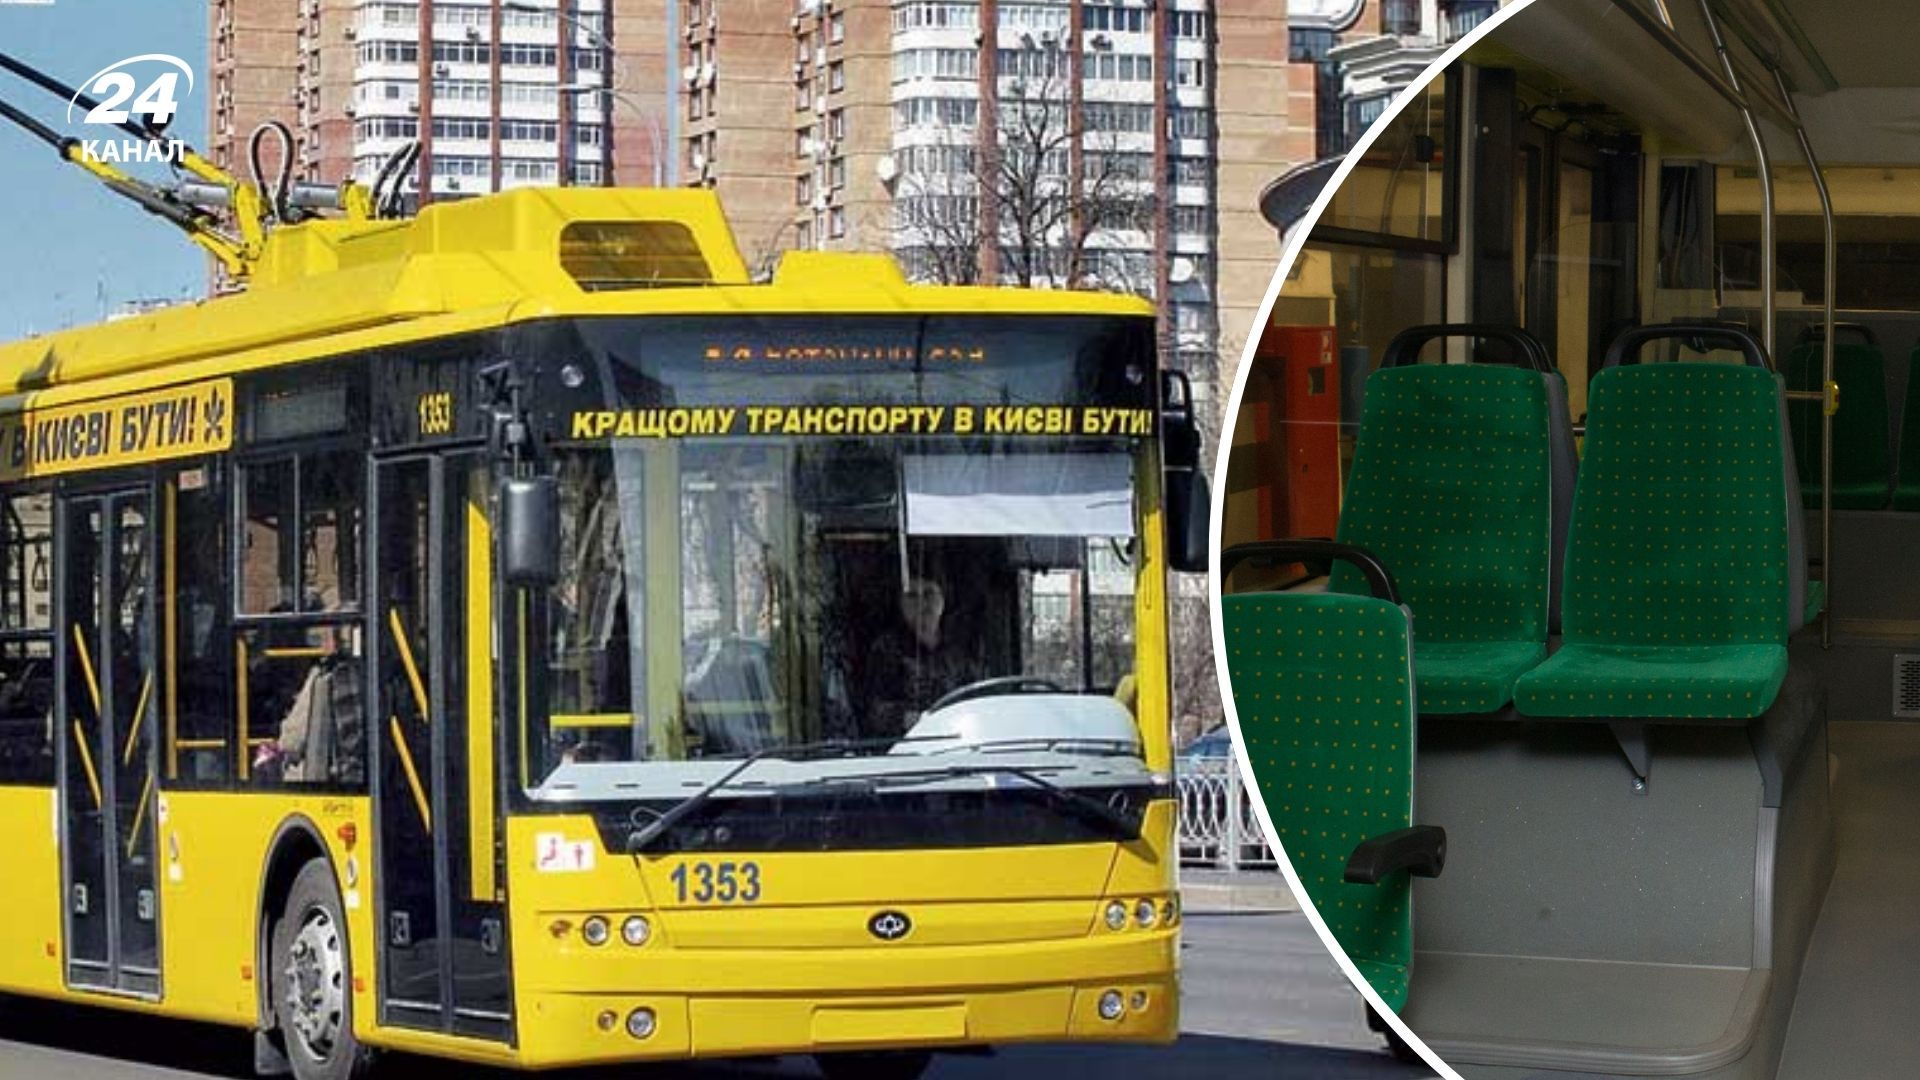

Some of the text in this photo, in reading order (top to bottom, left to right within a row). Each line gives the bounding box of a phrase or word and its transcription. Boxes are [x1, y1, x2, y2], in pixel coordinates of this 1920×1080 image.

[36, 410, 112, 463] КИЄВІ
[120, 396, 197, 452] БУТИ!
[419, 392, 451, 434] 1353
[571, 406, 1153, 439] КРАЩОМУ ТРАНСПОРТУ В КИЄВІ БУТИ!
[669, 861, 761, 904] 1353
